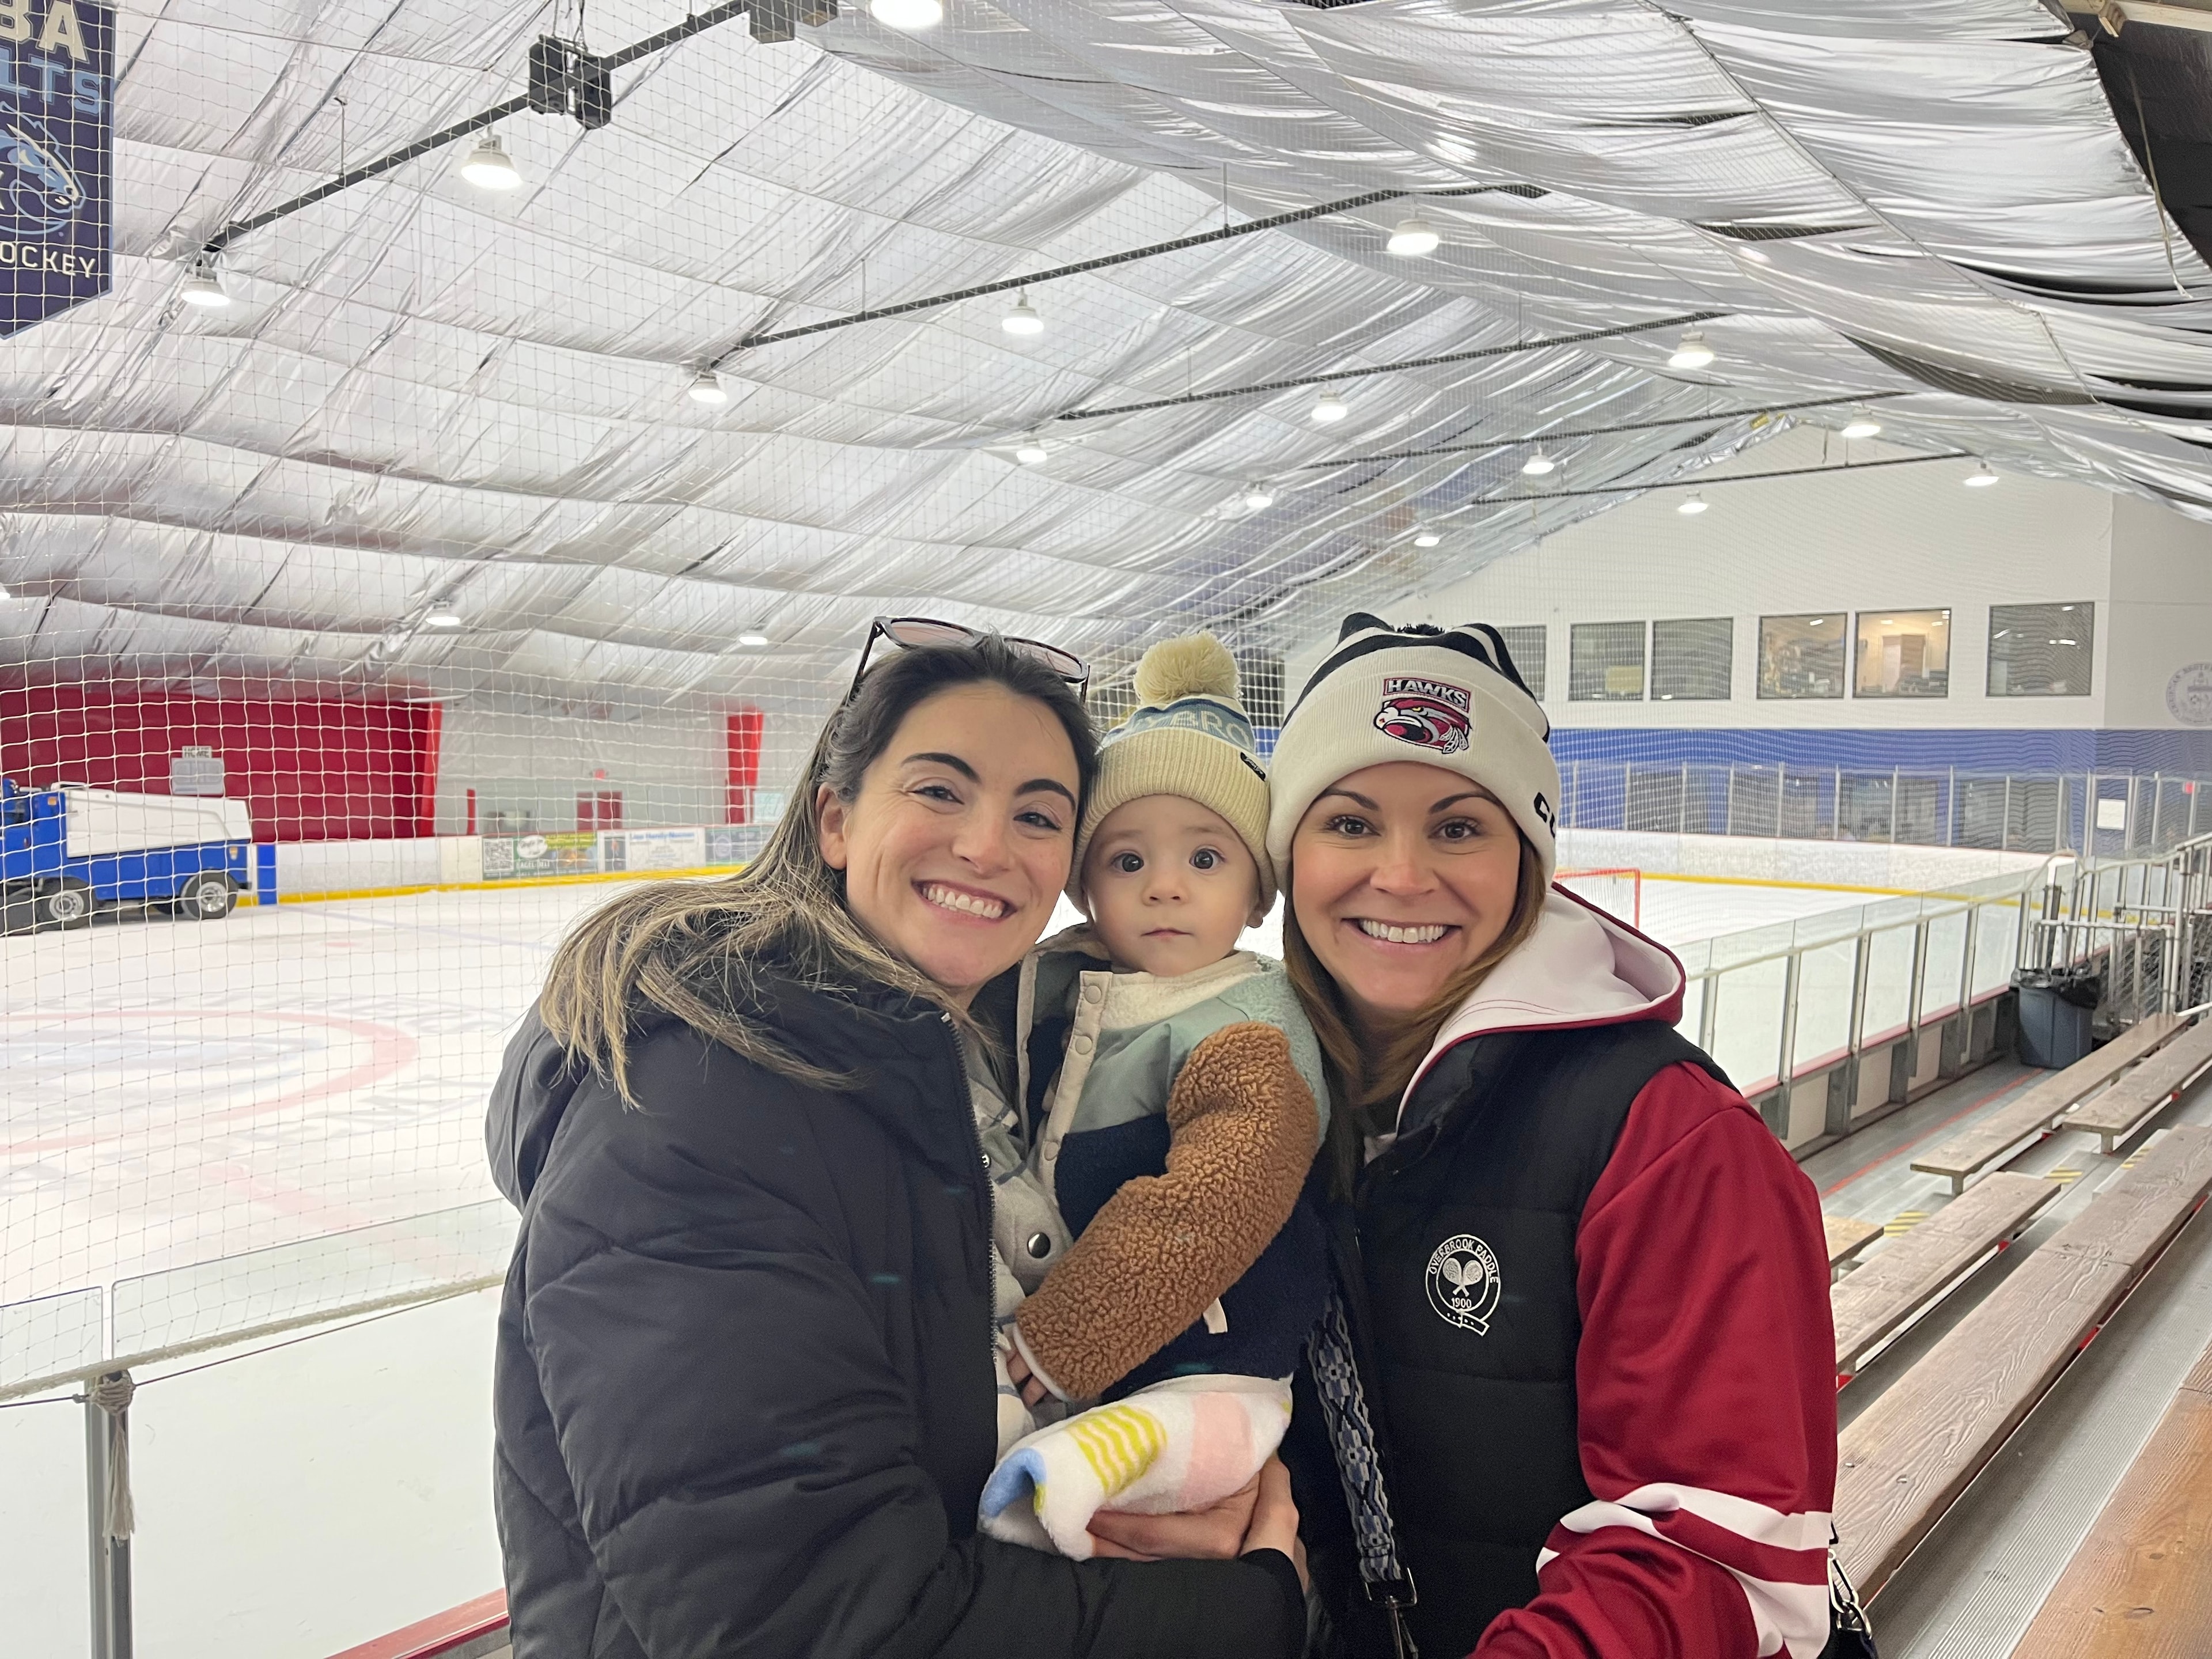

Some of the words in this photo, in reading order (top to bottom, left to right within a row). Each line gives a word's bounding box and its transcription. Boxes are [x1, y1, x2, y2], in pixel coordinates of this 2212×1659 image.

[0, 241, 96, 278] OCKEY
[1388, 680, 1467, 708] HAWKS
[184, 747, 210, 758] HOME
[1429, 1238, 1475, 1275] OVERBROOK
[1475, 1244, 1499, 1284] PADDLE
[1450, 1297, 1472, 1308] 1900
